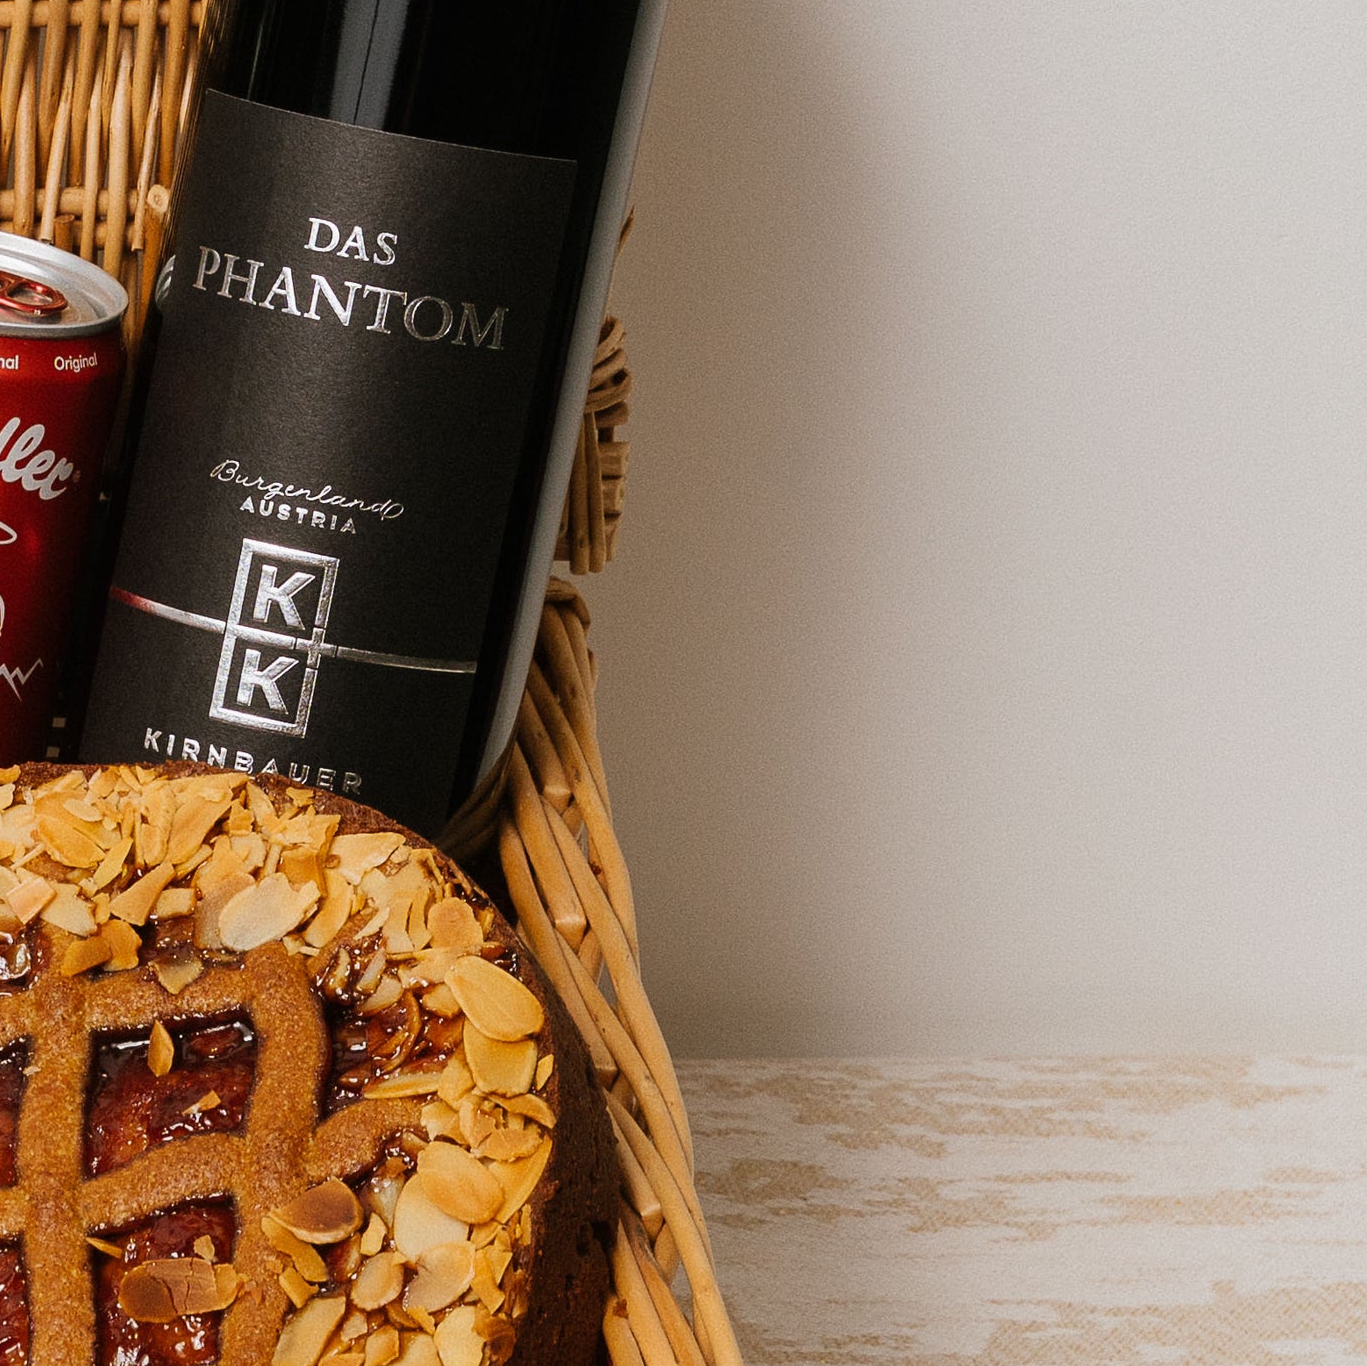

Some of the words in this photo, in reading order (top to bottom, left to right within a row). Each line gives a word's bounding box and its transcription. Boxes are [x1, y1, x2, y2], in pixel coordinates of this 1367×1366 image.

[303, 217, 398, 266] DAS
[192, 245, 509, 351] PHANTOM
[54, 352, 98, 373] Original
[210, 459, 405, 521] Burgenland
[239, 495, 358, 534] AUSTRIA
[253, 564, 316, 631] K
[236, 648, 299, 715] K
[143, 727, 363, 796] KIRNBAUER
